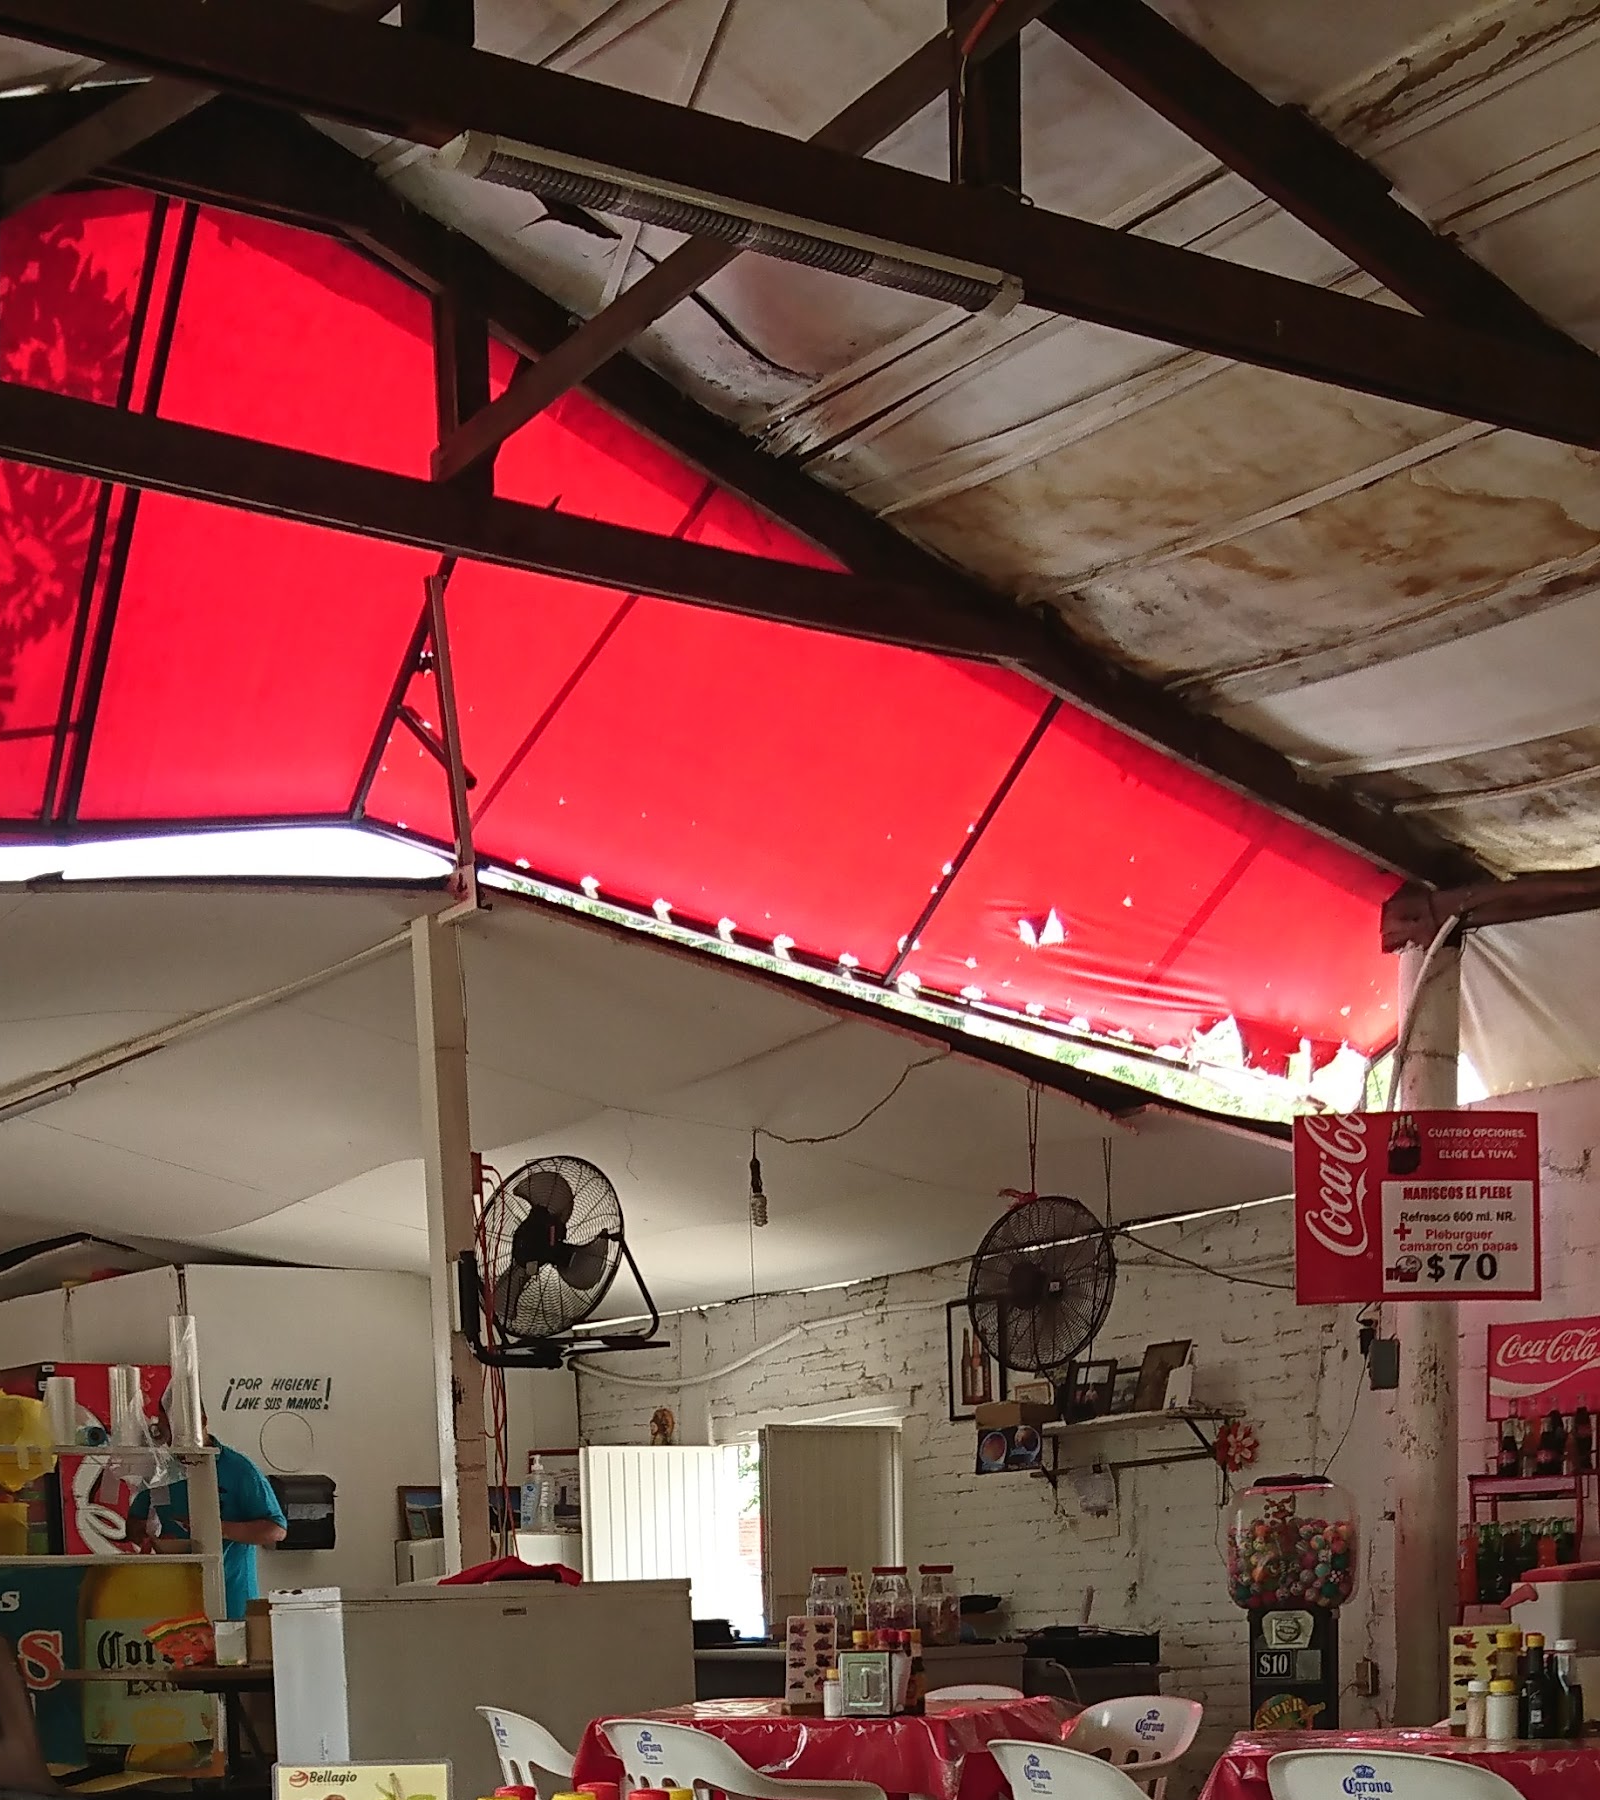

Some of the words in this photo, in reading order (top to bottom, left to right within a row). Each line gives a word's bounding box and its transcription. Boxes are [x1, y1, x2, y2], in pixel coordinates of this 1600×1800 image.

[1428, 1128, 1470, 1138] CUATRO
[1439, 1149, 1469, 1159] ELIGE
[1471, 1149, 1485, 1159] LA
[1403, 1187, 1464, 1200] MARISCOS
[1466, 1187, 1477, 1199] EL
[1480, 1186, 1513, 1199] PLEBE
[1400, 1211, 1451, 1222] Refresco
[1425, 1228, 1494, 1242] Pleburguer
[1482, 1243, 1519, 1254] papas
[1427, 1253, 1498, 1283] $70
[271, 1378, 320, 1391] HIGIENE
[235, 1397, 261, 1410] LAVE
[263, 1397, 282, 1410] SUS
[1260, 1653, 1288, 1675] $10
[309, 1770, 358, 1786] Bellagio
[1342, 1776, 1394, 1795] Corona
